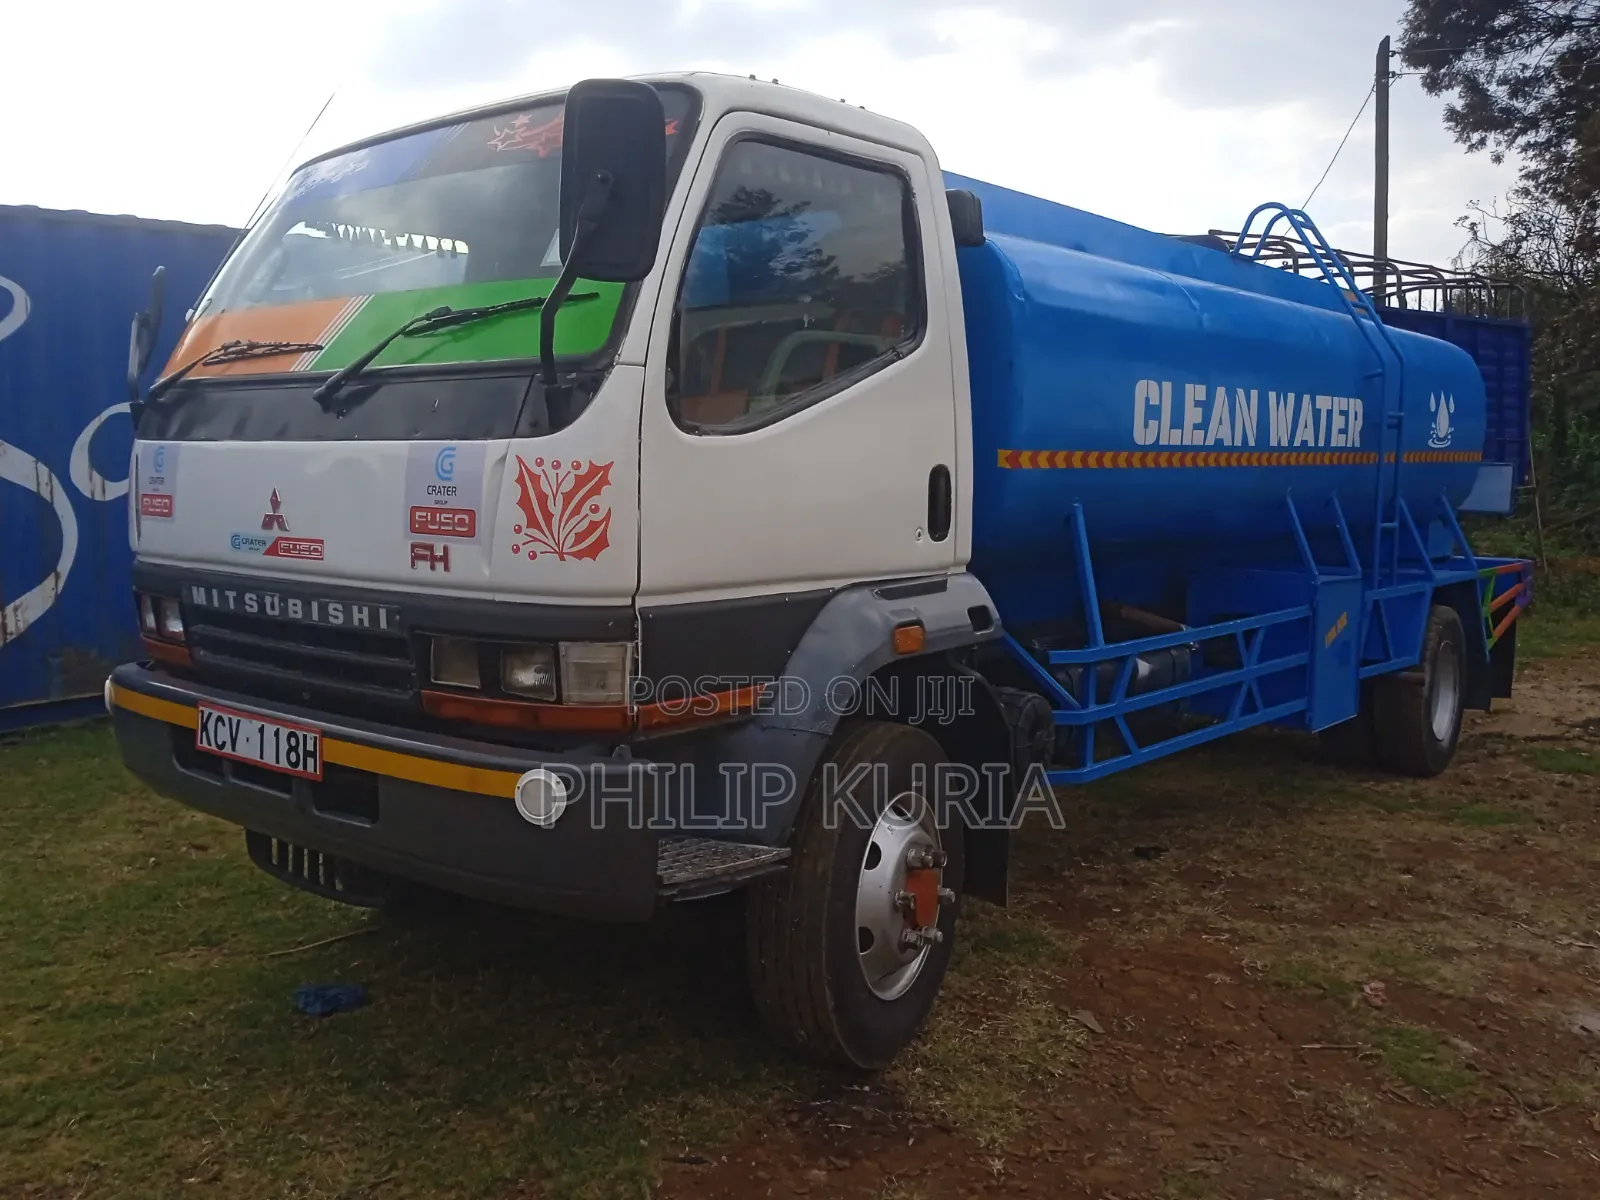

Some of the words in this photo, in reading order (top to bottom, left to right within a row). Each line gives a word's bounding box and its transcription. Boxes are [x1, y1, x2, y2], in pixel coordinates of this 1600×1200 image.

[1133, 379, 1258, 447] CLEAN
[1268, 390, 1364, 448] WATER
[426, 484, 458, 497] CRATER
[414, 510, 470, 532] FUSO
[241, 537, 267, 547] CRATER
[280, 542, 322, 555] FUSO
[410, 541, 451, 573] FH
[191, 585, 388, 630] MITSUBISHI
